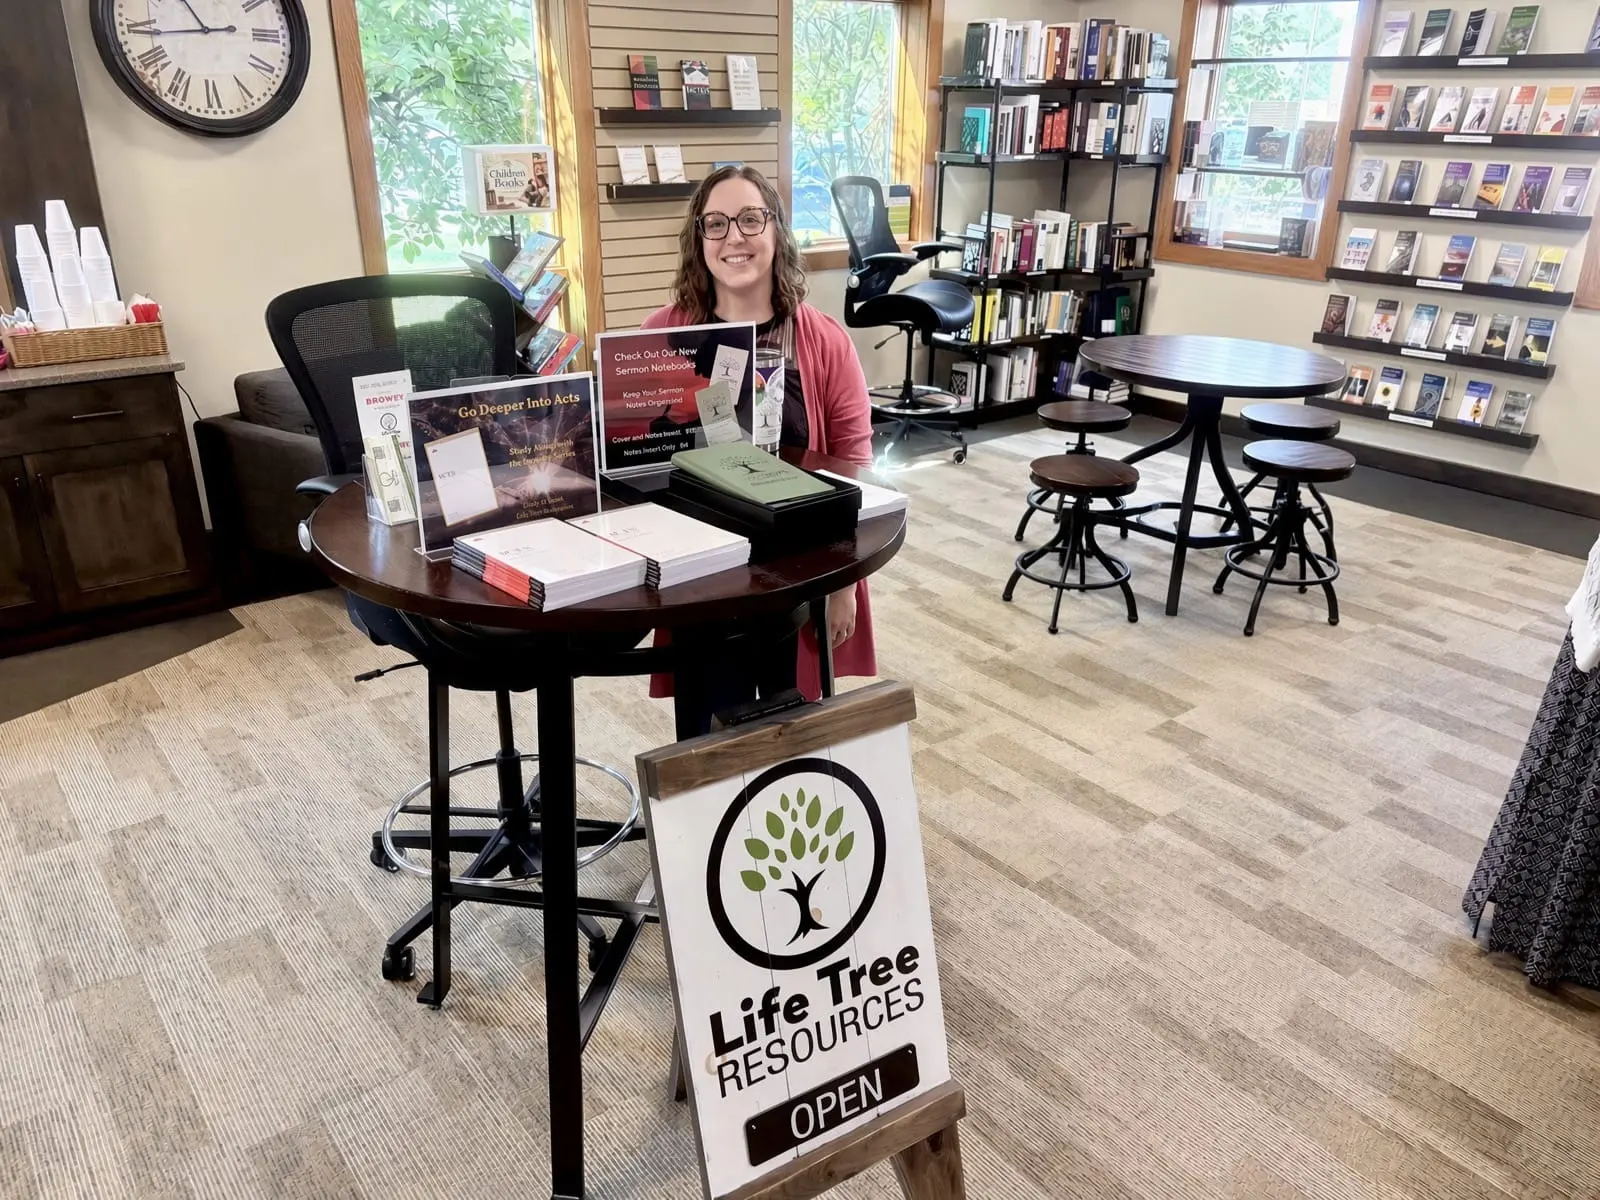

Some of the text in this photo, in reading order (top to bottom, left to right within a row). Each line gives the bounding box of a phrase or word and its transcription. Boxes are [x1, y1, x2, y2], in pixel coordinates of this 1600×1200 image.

[489, 167, 526, 179] Children
[494, 178, 525, 188] Books
[614, 347, 698, 362] Check Out Our New
[615, 361, 697, 376] Sermon Notebooks
[623, 387, 684, 400] Keep Your Sermon
[458, 393, 580, 418] Go Deeper Into Acts
[626, 401, 647, 409] Notes
[612, 436, 631, 444] Cover
[645, 431, 662, 439] Notes
[509, 445, 532, 456] Study
[624, 449, 642, 457] Notes
[661, 443, 676, 451] Only
[709, 945, 920, 1058] Life Tree
[717, 977, 925, 1098] RESOURCES
[790, 1068, 884, 1139] OPEN
